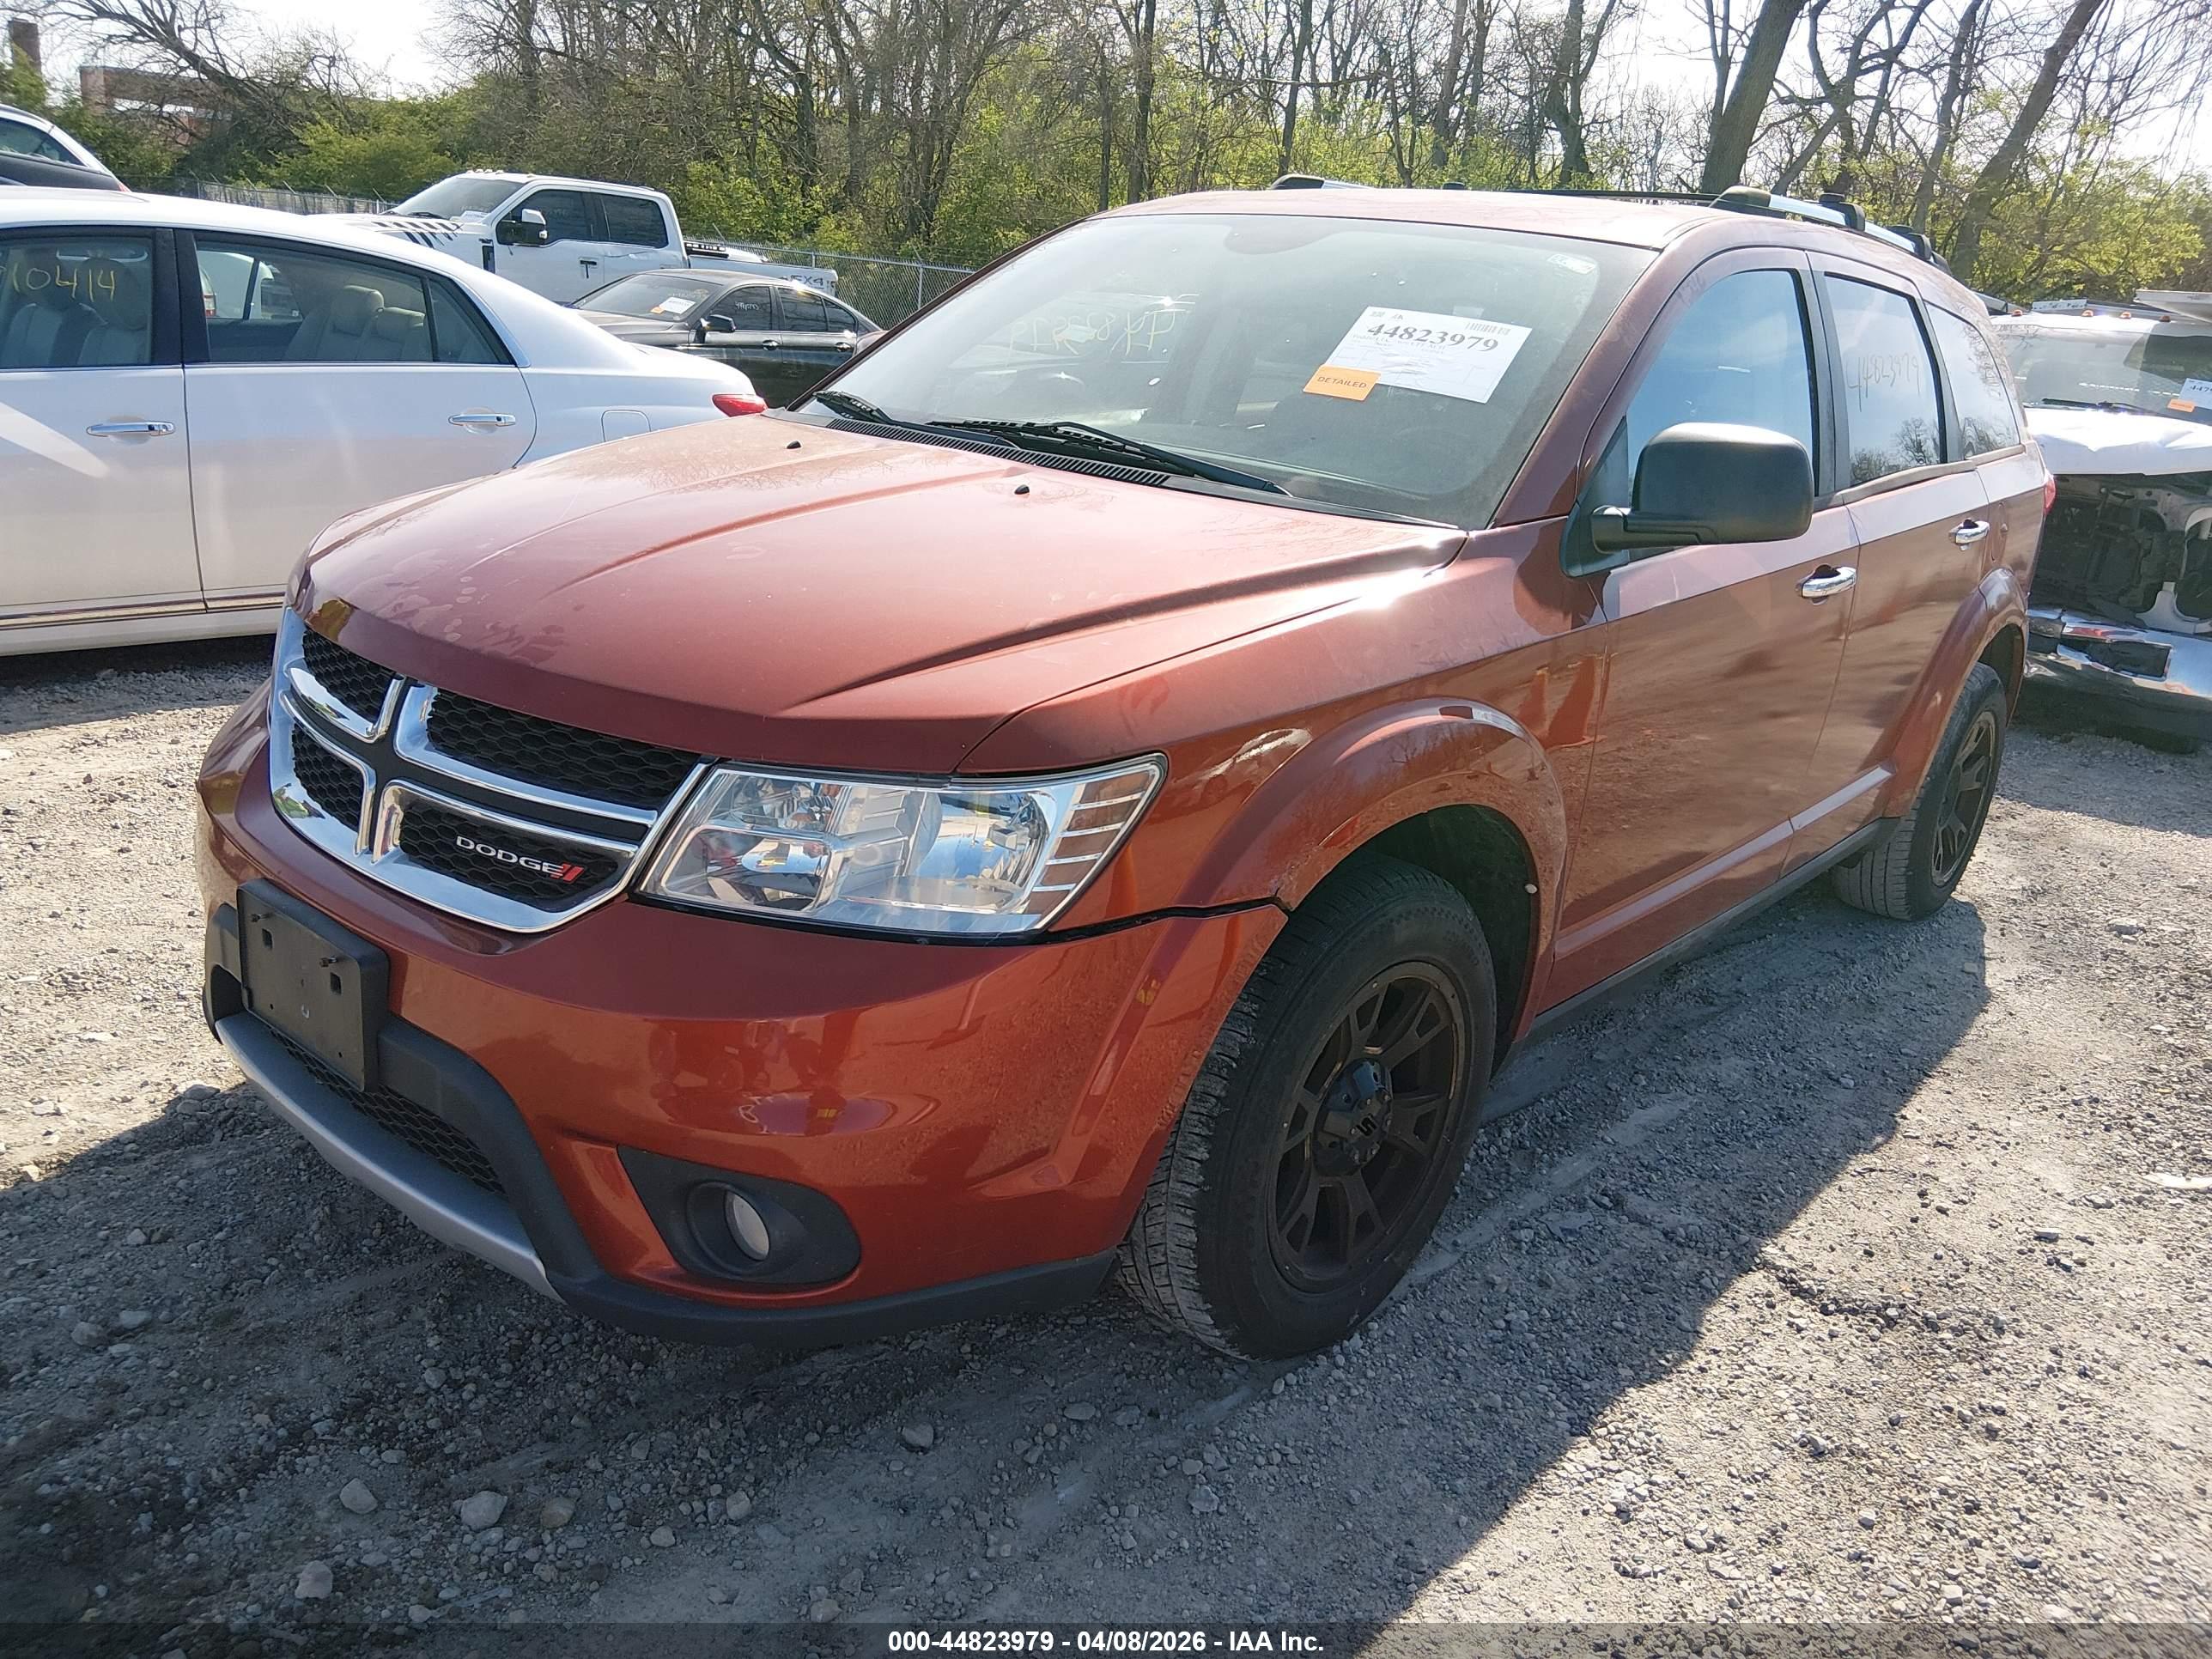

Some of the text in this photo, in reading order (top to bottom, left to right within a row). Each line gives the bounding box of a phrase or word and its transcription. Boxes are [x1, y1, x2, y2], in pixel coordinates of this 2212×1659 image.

[1367, 323, 1498, 352] 44823979
[1317, 375, 1368, 389] DETAILED
[456, 836, 564, 877] DODGE
